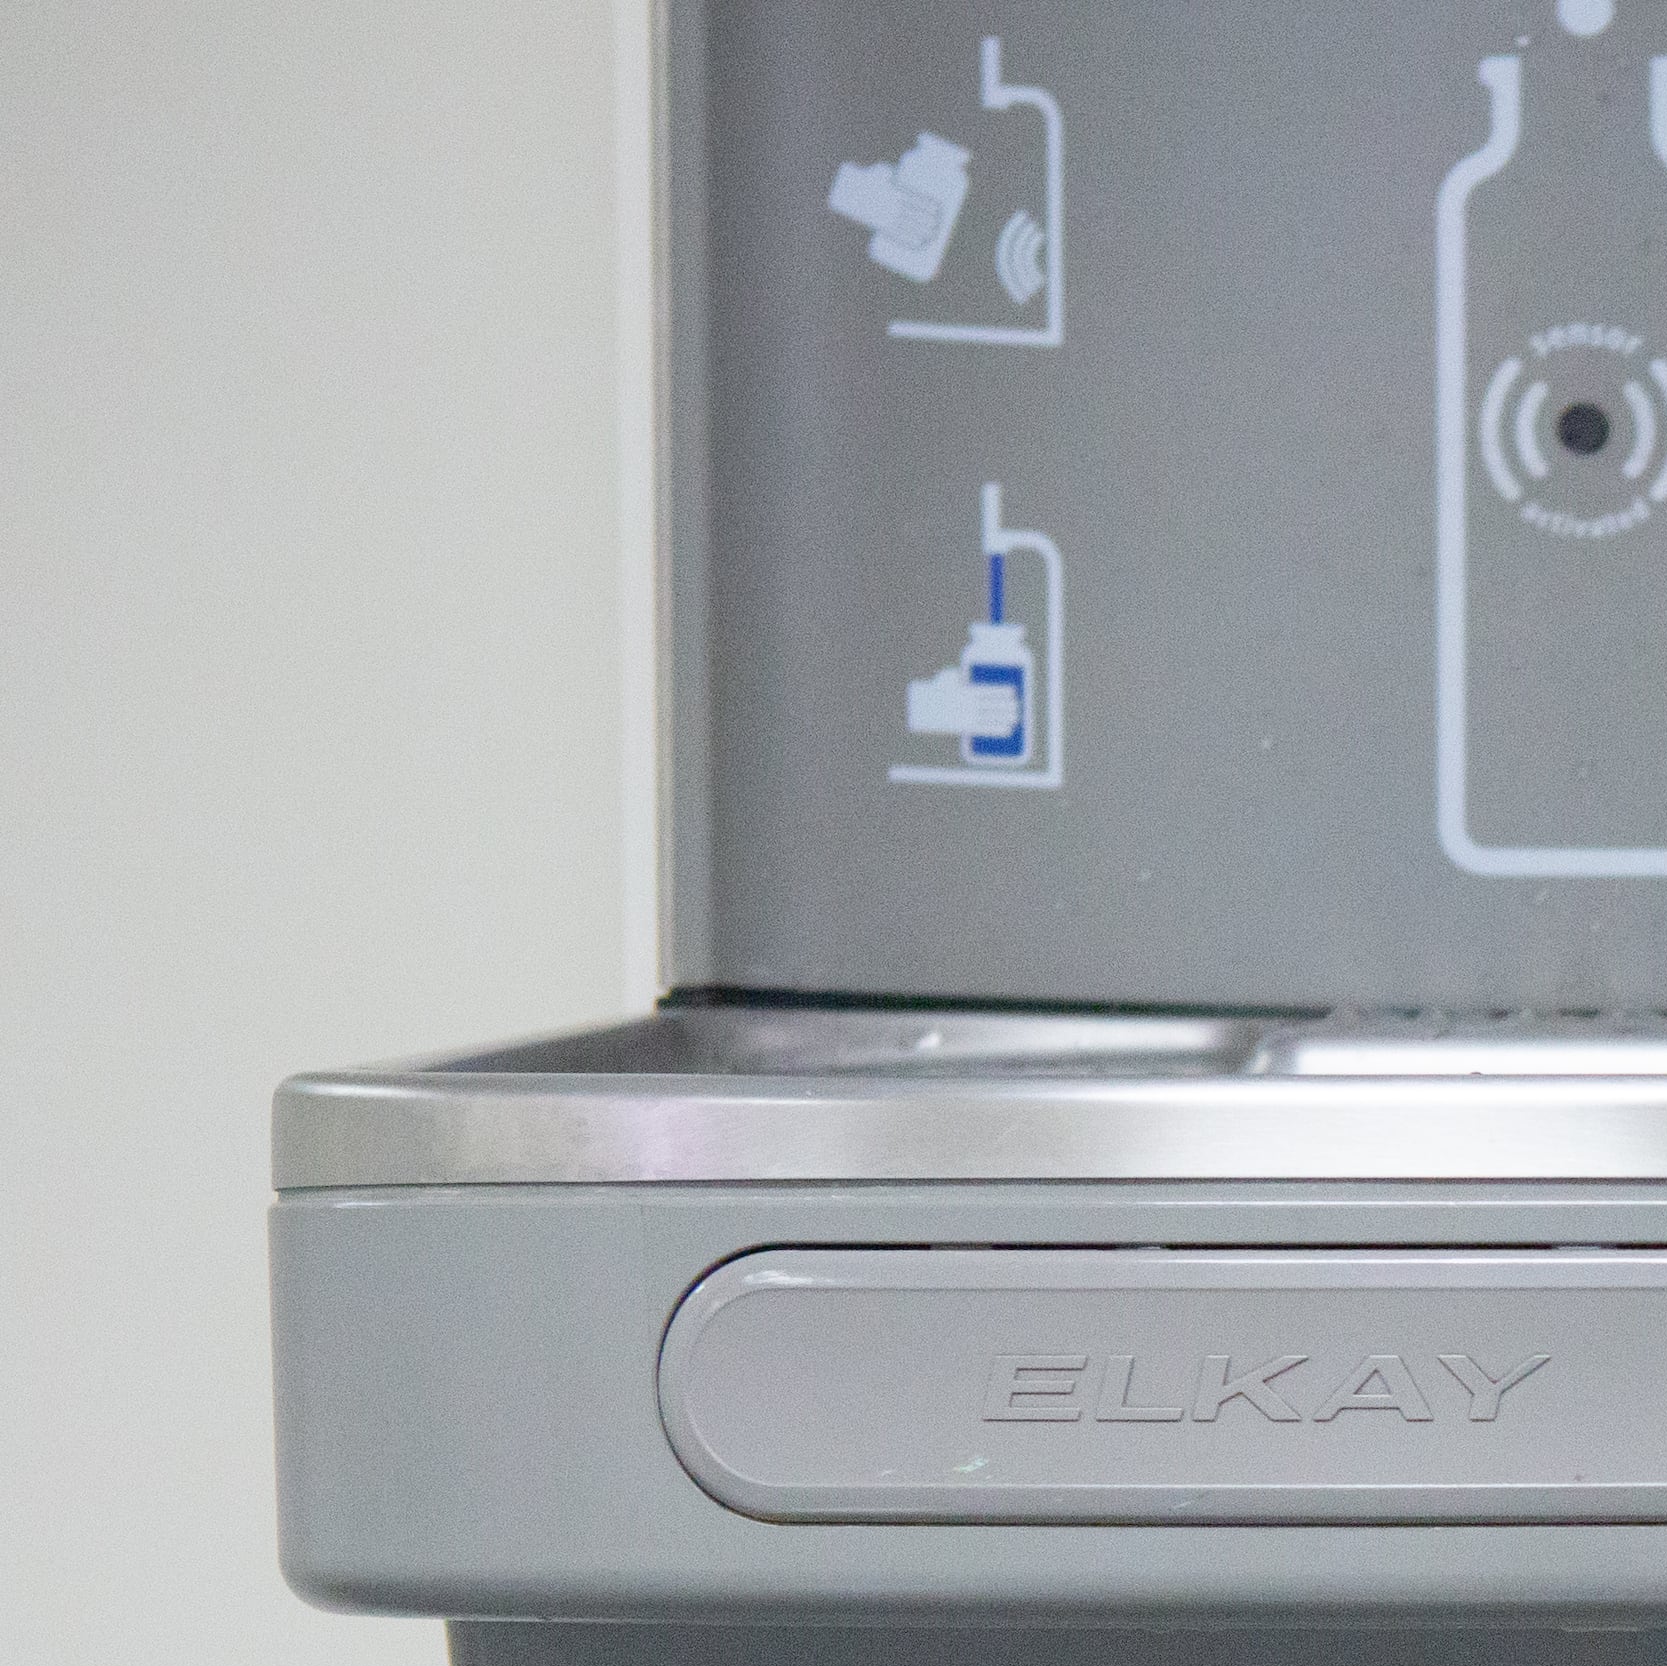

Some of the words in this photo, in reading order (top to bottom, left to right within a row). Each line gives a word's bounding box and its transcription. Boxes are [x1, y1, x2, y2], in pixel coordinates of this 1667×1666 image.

[1530, 323, 1643, 357] sensor
[1520, 500, 1649, 538] activated
[982, 1353, 1552, 1423] ELKAY
